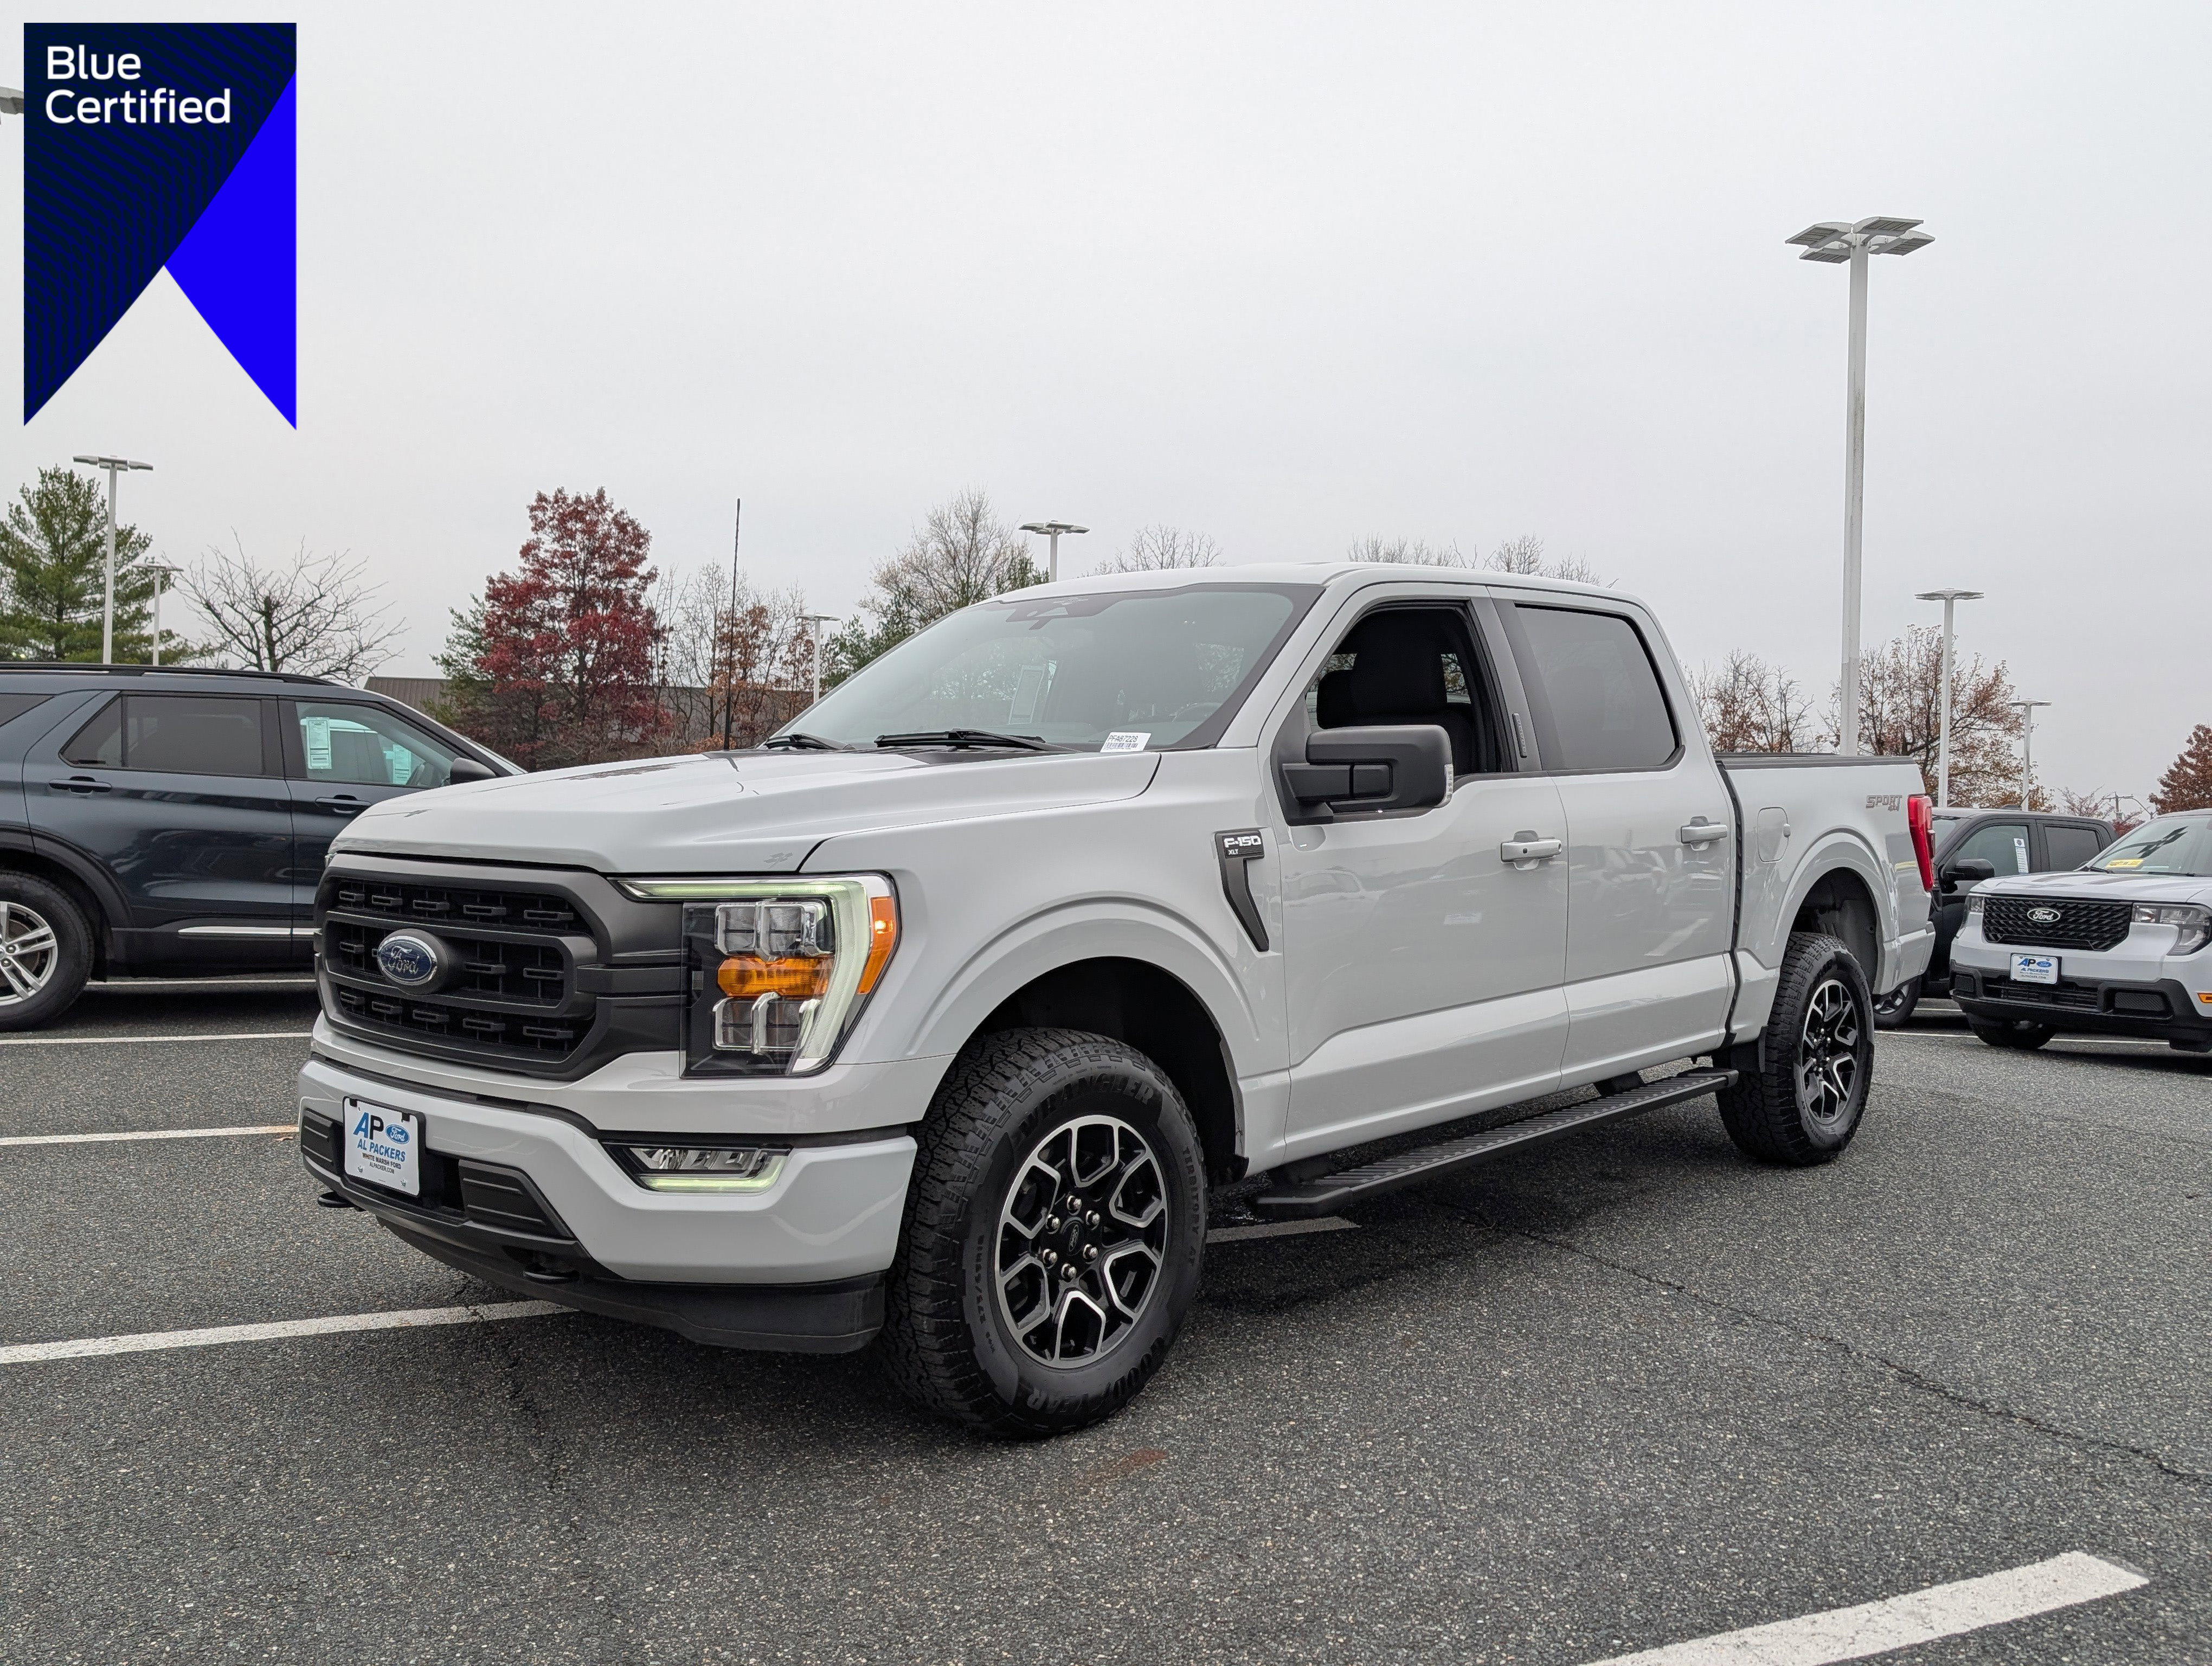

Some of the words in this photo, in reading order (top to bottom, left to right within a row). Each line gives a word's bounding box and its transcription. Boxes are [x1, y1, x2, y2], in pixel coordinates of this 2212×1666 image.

[1866, 794, 1902, 811] SPORT
[1224, 835, 1262, 848] F-150
[2033, 909, 2054, 920] Ford
[387, 945, 420, 975] Ford
[2017, 958, 2036, 967] AP
[353, 1112, 384, 1140] AP
[390, 1126, 406, 1142] Ford
[357, 1138, 367, 1150] AL
[369, 1142, 406, 1162] PACKERS
[1182, 1146, 1200, 1235] TERRITORY
